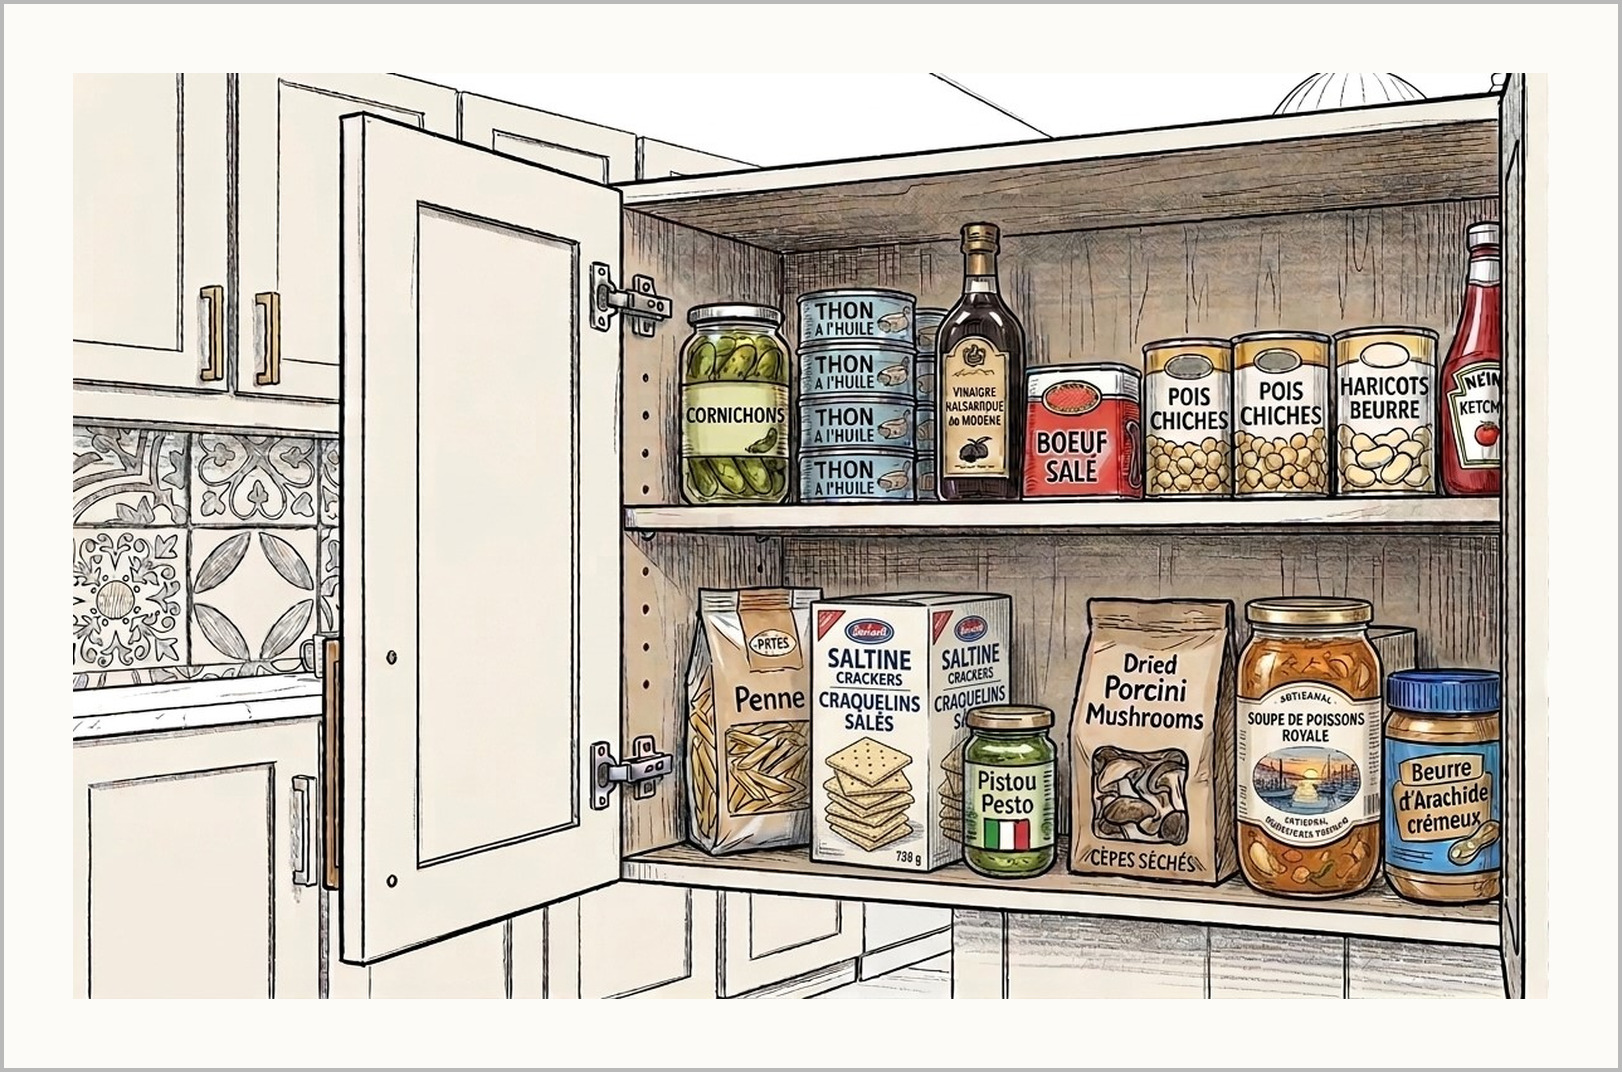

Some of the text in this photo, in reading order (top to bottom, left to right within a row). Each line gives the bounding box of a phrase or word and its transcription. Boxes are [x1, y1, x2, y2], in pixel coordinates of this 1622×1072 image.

[815, 301, 873, 319] THON
[815, 355, 873, 374] THON
[953, 387, 996, 397] VINAIGRE
[1260, 381, 1303, 401] POIS
[1341, 376, 1429, 396] HARICOTS
[1168, 387, 1210, 406] POIS
[686, 406, 785, 425] CORNICHONS
[815, 407, 873, 426] THON
[1240, 406, 1322, 426] CHICHES
[1351, 400, 1420, 419] BEURRE
[1151, 411, 1229, 430] CHICHES
[1037, 431, 1107, 454] BOEUF
[815, 460, 873, 479] THON
[1046, 453, 1097, 482] SALÉ
[828, 648, 912, 671] SALTINE
[942, 643, 1000, 671] SALTINE
[1124, 653, 1178, 675] Dried
[836, 672, 903, 686] CRACKERS
[948, 667, 994, 684] CRACKERS
[1105, 675, 1187, 702] Porcini
[735, 686, 805, 713] Penne
[819, 691, 921, 712] CRAQUELINS
[934, 685, 1006, 713] CRAQUELINS
[1086, 702, 1204, 730] Mushrooms
[1248, 712, 1365, 726] SOUPE DE POISSONS
[1282, 729, 1329, 742] ROYALE
[978, 770, 1036, 792] Pistou
[1412, 761, 1471, 782] Beurre
[982, 793, 1034, 814] Pesto
[1400, 783, 1488, 811] d'Arachide
[1408, 810, 1481, 834] crémeux
[896, 850, 922, 866] 738 g
[1138, 850, 1196, 872] SÉCHÉS
